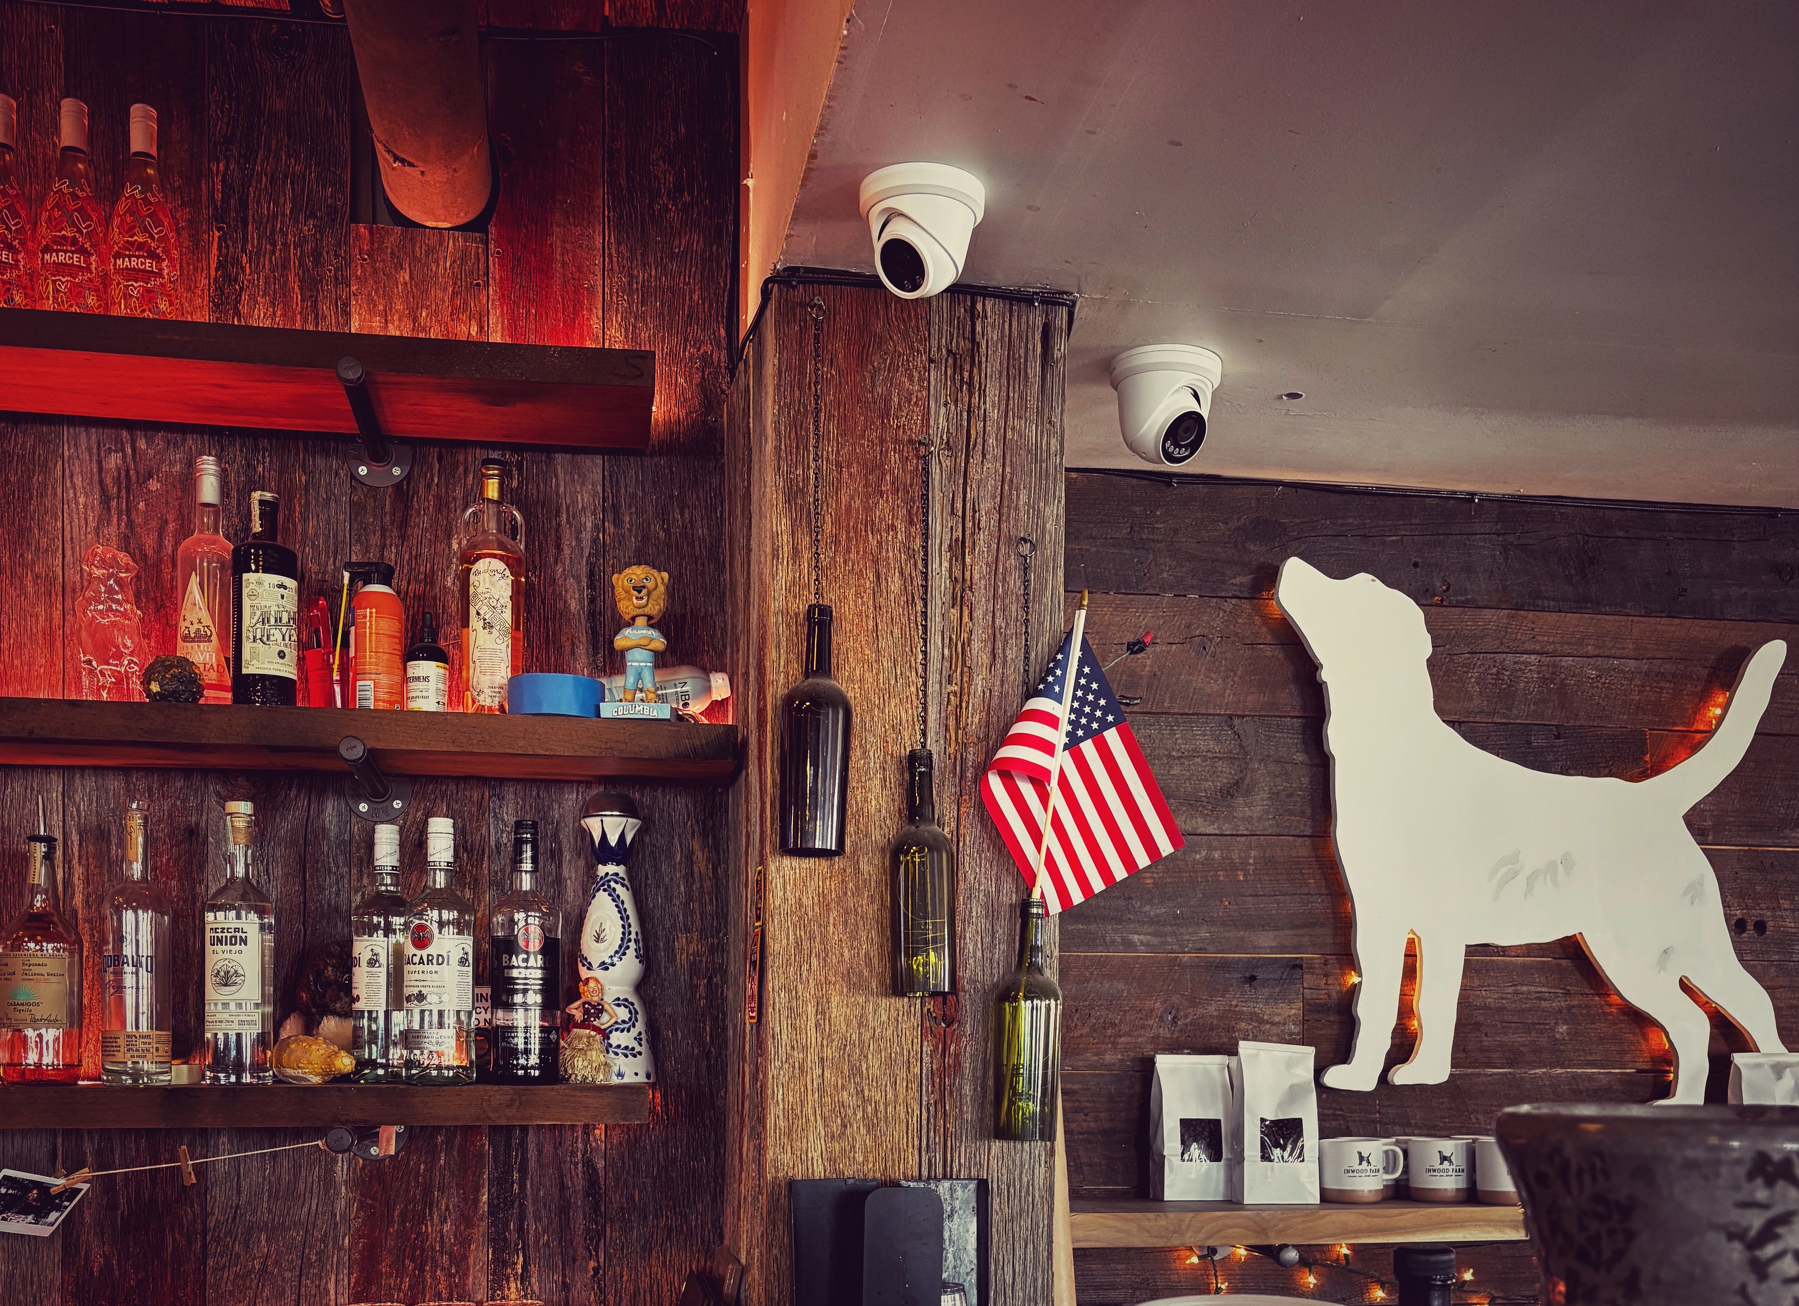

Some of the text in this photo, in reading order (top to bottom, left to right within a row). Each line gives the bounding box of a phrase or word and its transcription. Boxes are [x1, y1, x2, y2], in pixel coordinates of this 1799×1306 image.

[0, 250, 15, 264] EL
[44, 252, 87, 267] MARCEL
[116, 257, 159, 272] MARCEL
[470, 592, 512, 639] BITTERS
[612, 704, 658, 717] COLUMBIA
[476, 993, 491, 1003] IN
